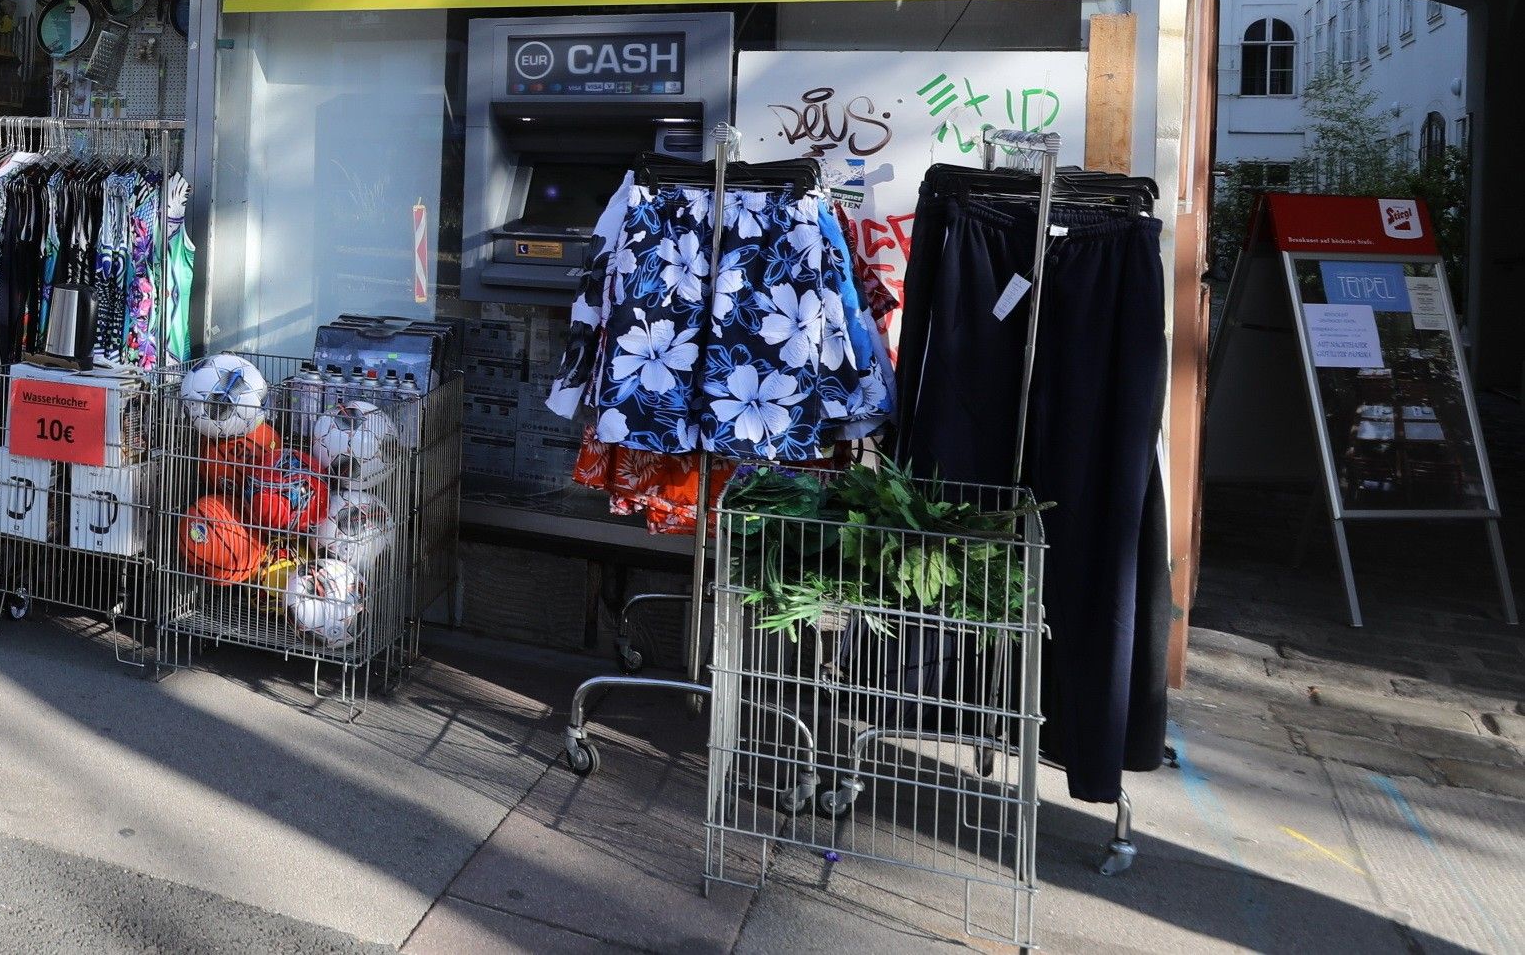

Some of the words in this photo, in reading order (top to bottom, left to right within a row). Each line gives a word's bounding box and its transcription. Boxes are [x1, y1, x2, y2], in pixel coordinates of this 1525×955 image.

[521, 55, 548, 66] EUR
[567, 42, 678, 75] CASH
[1337, 276, 1397, 299] TEMPEL
[22, 391, 89, 408] Wasserkocher
[36, 417, 76, 444] 10€
